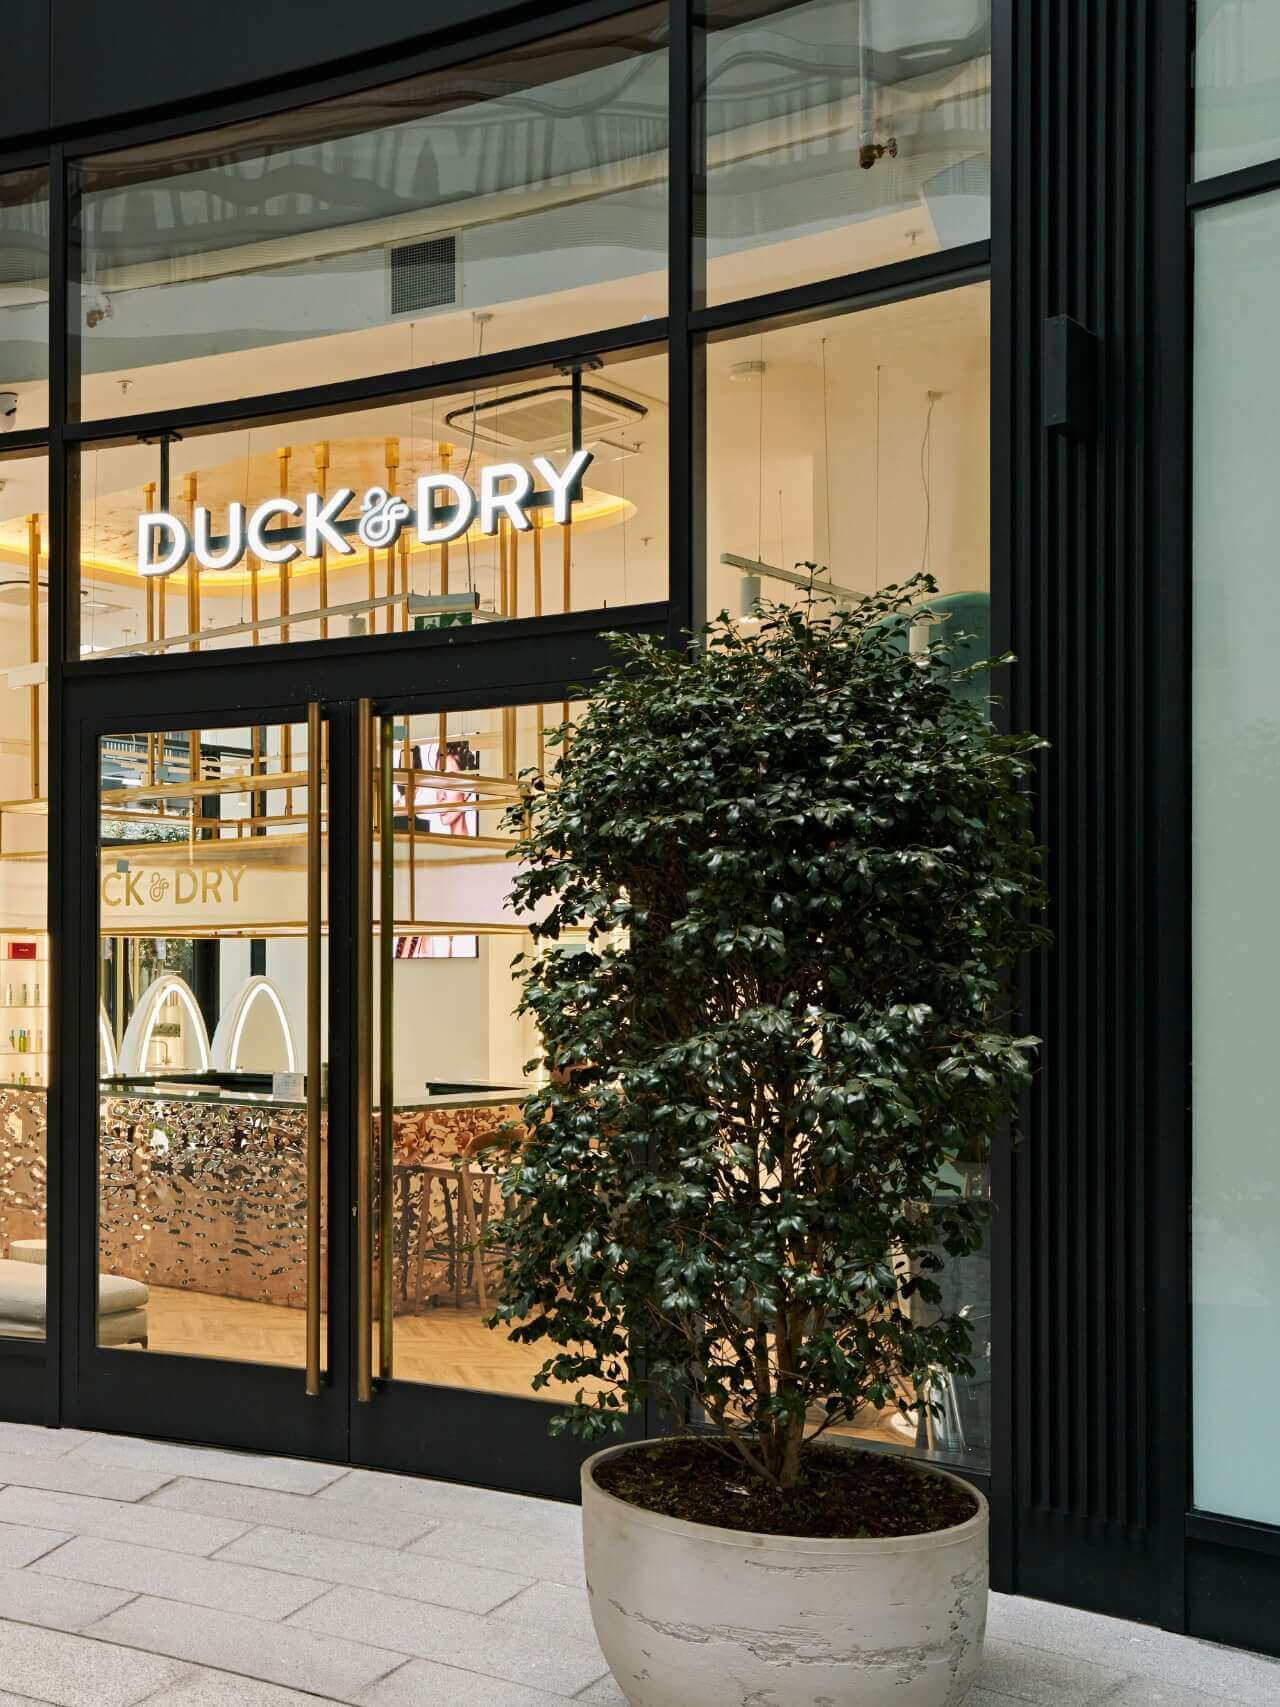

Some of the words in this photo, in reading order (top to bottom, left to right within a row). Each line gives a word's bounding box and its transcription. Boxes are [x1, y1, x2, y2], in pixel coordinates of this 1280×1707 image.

[137, 489, 356, 577] DUCK
[358, 487, 410, 549] &
[418, 451, 595, 544] DRY
[102, 869, 145, 907] CK
[149, 872, 170, 903] &
[175, 864, 247, 905] DRY
